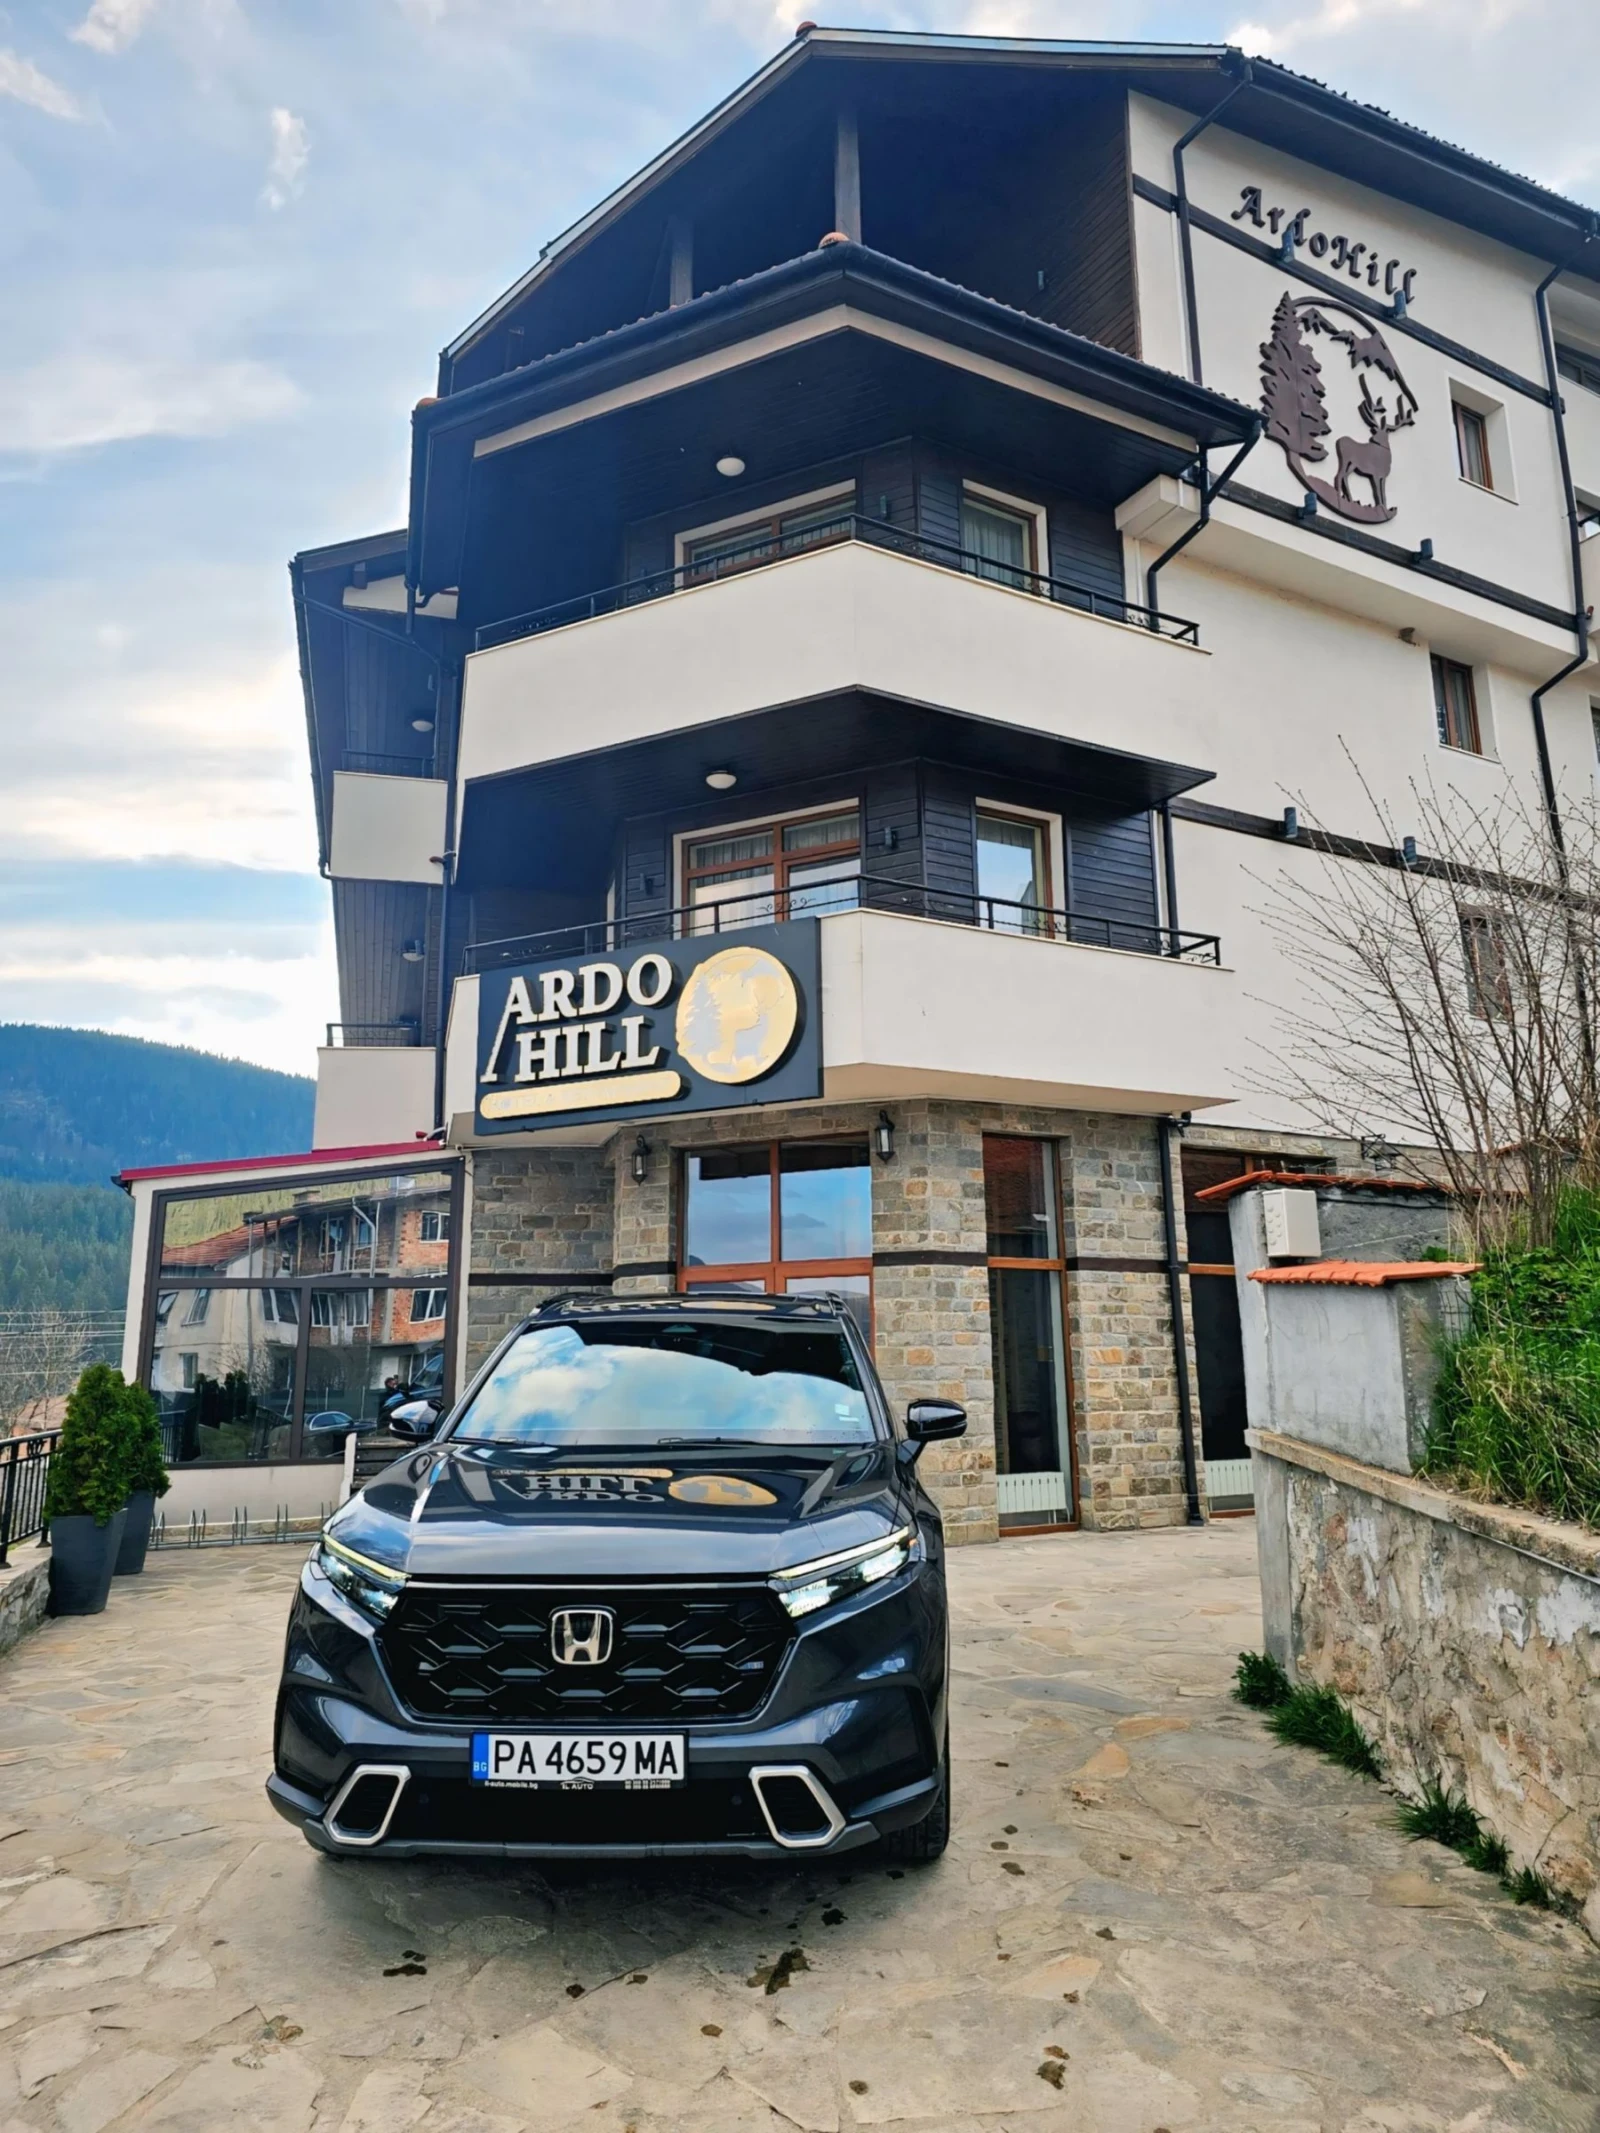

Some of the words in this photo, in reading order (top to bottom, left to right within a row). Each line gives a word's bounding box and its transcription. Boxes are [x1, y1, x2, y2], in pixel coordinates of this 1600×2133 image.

[480, 953, 674, 1083] ARDO
[515, 1015, 660, 1083] HILL
[473, 1761, 487, 1772] BG
[494, 1739, 537, 1774] PA
[545, 1740, 628, 1775] 4659
[634, 1740, 678, 1775] MA
